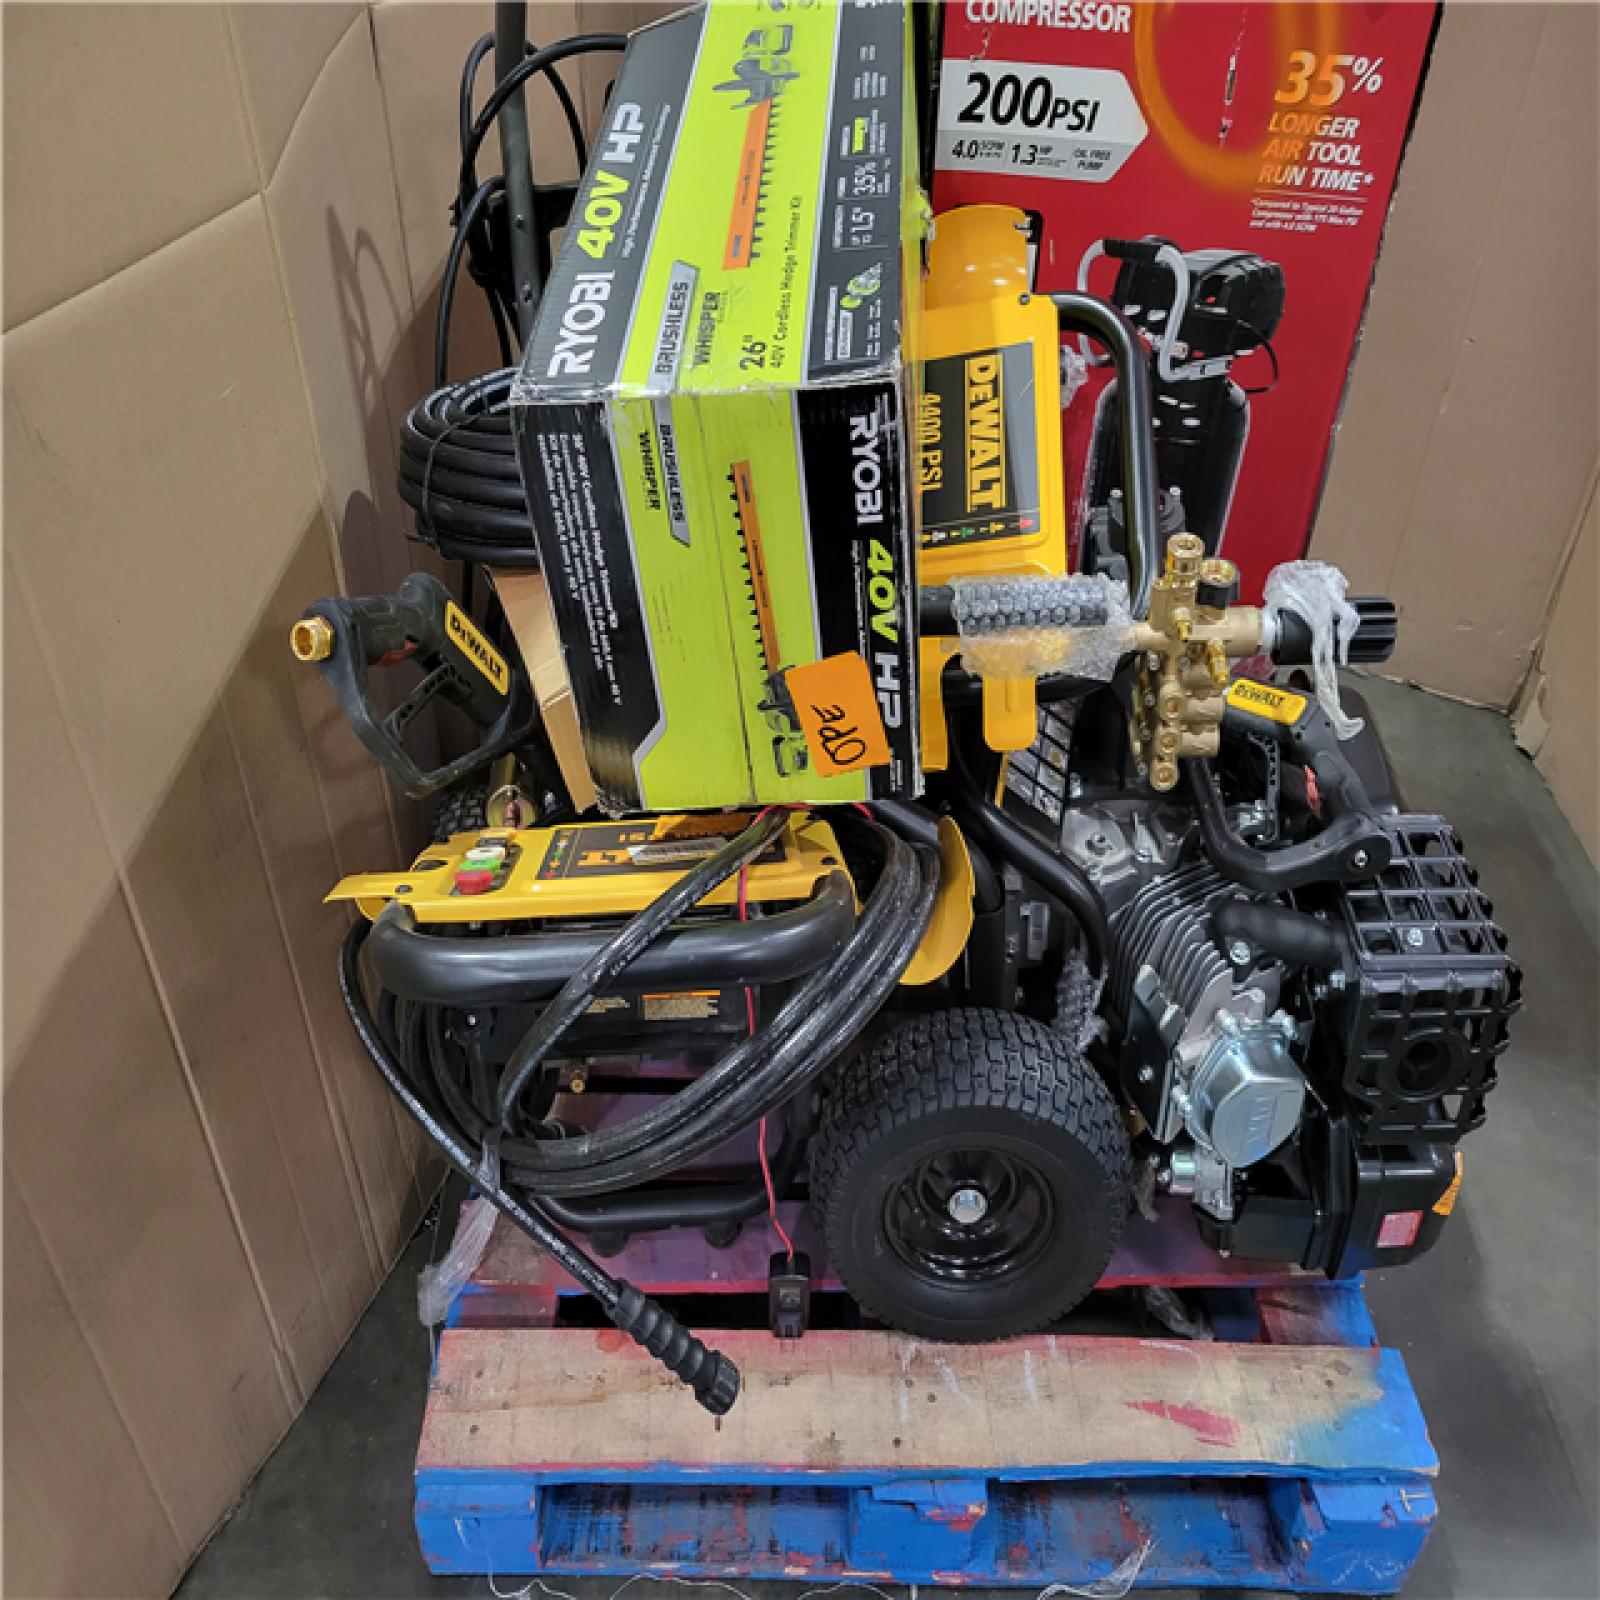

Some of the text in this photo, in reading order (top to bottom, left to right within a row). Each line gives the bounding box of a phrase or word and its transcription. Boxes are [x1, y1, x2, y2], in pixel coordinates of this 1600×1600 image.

[966, 0, 1131, 33] COMPRESSOR
[1274, 50, 1383, 107] 35%
[602, 102, 644, 163] HP
[952, 139, 979, 160] 4.0
[1012, 144, 1038, 166] 1.3
[1262, 139, 1362, 166] AIR TOOL
[1267, 111, 1361, 139] LONGER
[1257, 164, 1308, 186] RUN
[576, 169, 630, 260] 40V
[547, 270, 616, 378] RYOBI
[655, 281, 689, 375] BRUSHLESS
[692, 291, 721, 366] WHISPER
[970, 354, 1006, 513] DEWALT
[849, 410, 884, 525] RYOBI
[919, 449, 943, 491] PSI
[867, 539, 898, 643] 40V
[874, 652, 902, 728] HP
[810, 703, 866, 766] OPE
